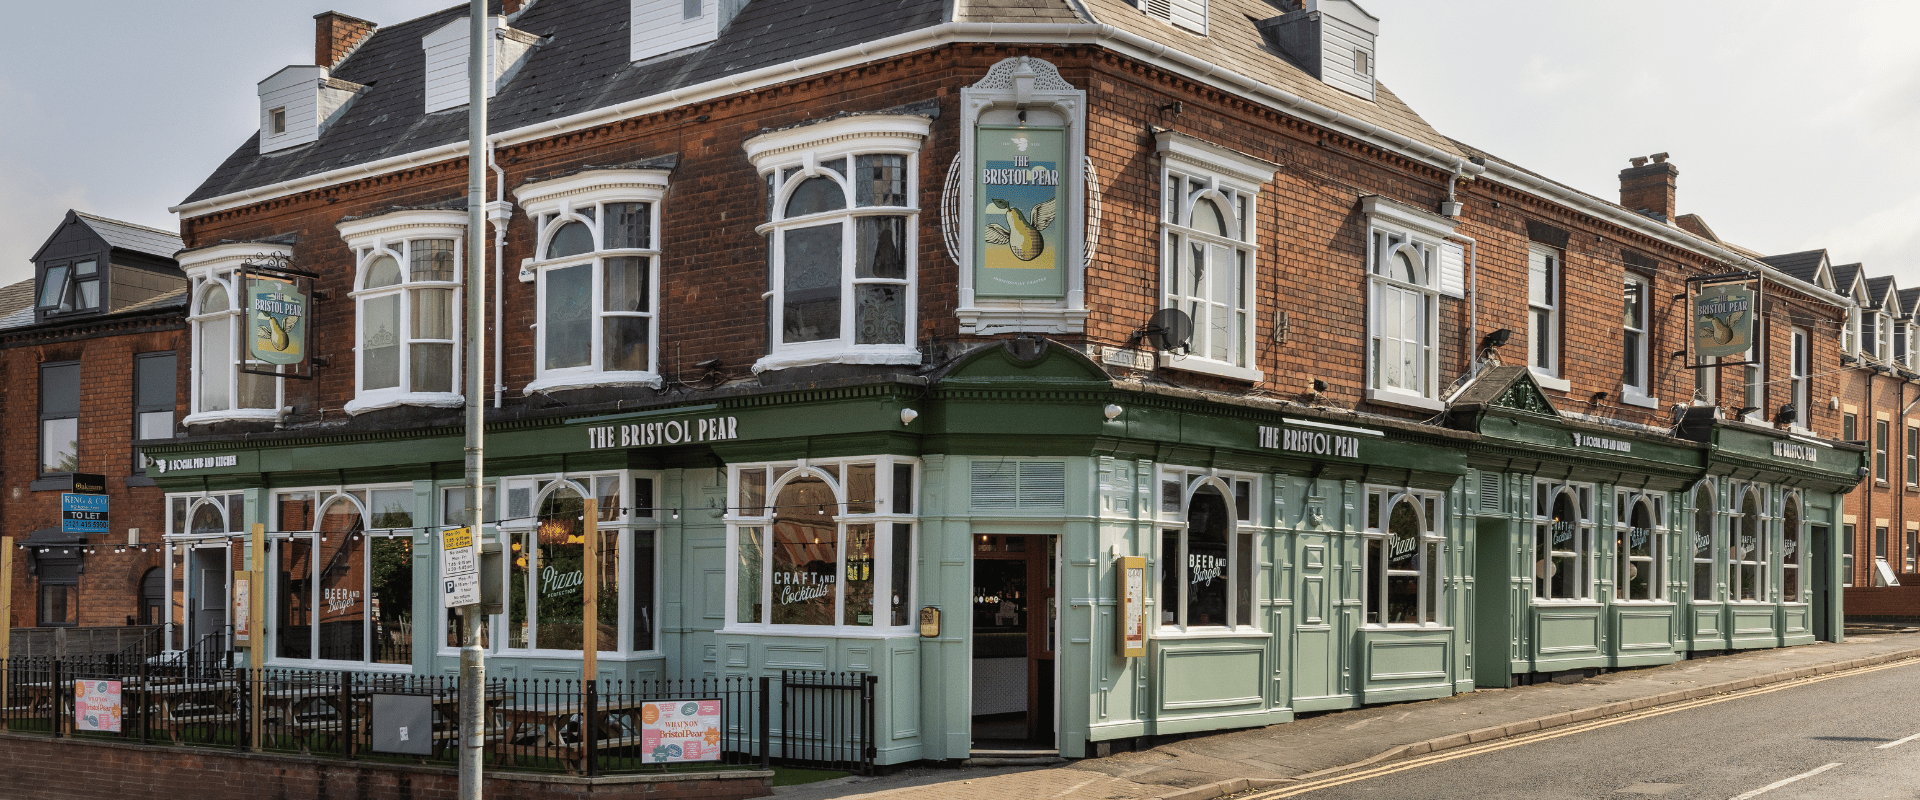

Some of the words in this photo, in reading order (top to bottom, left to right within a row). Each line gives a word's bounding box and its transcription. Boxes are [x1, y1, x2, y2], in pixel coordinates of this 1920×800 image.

[1014, 156, 1029, 167] THE
[983, 169, 1028, 185] BRISTOL
[1032, 170, 1059, 186] PEAR
[274, 292, 284, 301] THE
[255, 298, 283, 314] BRISTOL
[285, 304, 302, 317] PEAR
[1698, 303, 1727, 316] BRISTOL
[1730, 301, 1748, 312] PEAR
[588, 426, 615, 449] THE
[621, 420, 692, 447] BRISTOL
[698, 416, 738, 441] PEAR
[1259, 426, 1279, 449] THE
[1283, 429, 1331, 455] BRISTOL
[1335, 436, 1359, 458] PEAR
[1586, 436, 1600, 448] SOCIAL
[1617, 441, 1631, 452] KITCHEN
[1773, 442, 1782, 456] THE
[1784, 443, 1804, 460] BRISTOL
[1806, 447, 1817, 462] PEAR
[169, 460, 173, 470] A
[174, 459, 193, 470] SOCIAL
[194, 458, 204, 469] PUB
[204, 457, 214, 468] AND
[215, 455, 236, 467] KITCHEN
[1390, 532, 1416, 558] Pizza
[1189, 554, 1214, 568] BEER
[1215, 558, 1226, 567] AND
[542, 566, 584, 593] Pizza
[774, 572, 818, 584] CRAFT
[820, 575, 835, 583] AND
[1192, 565, 1221, 587] Burger
[325, 588, 347, 600] BEER
[447, 582, 454, 592] P
[782, 583, 829, 605] Cocktails
[327, 597, 354, 615] Burger
[660, 730, 684, 738] Bristol
